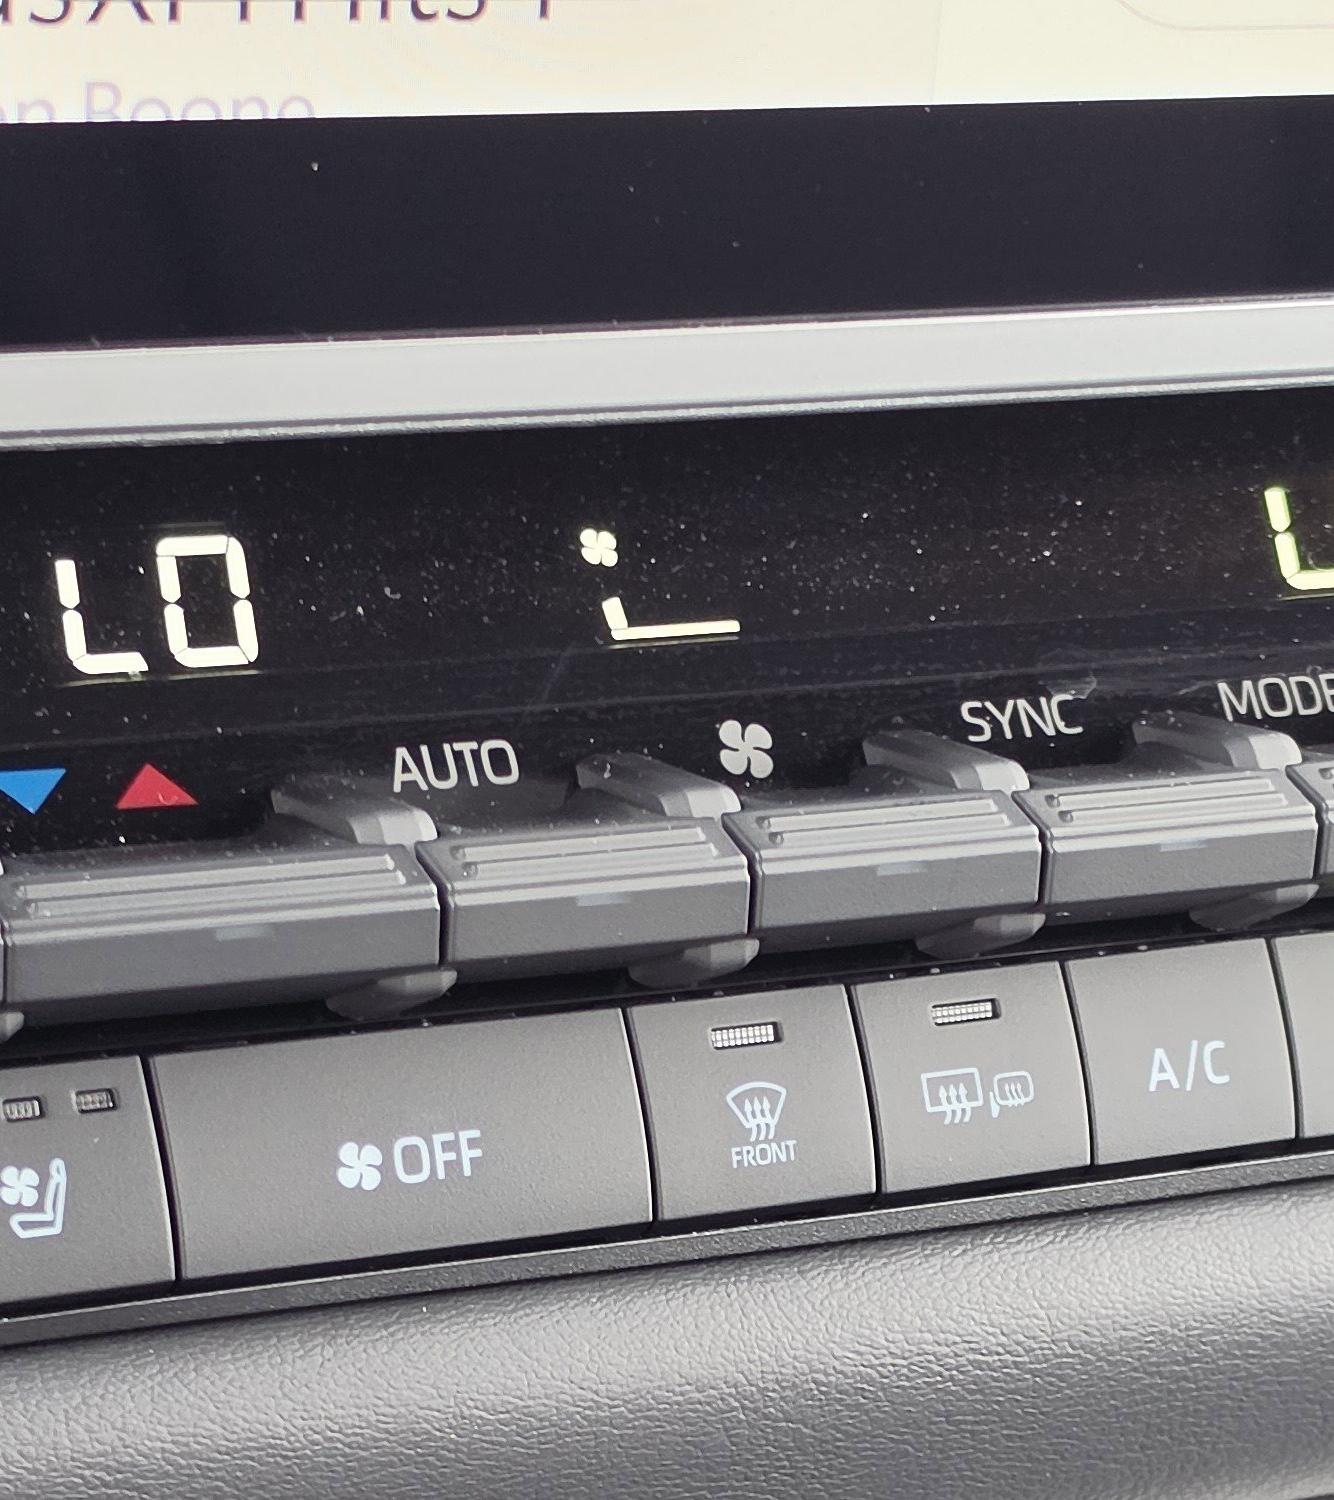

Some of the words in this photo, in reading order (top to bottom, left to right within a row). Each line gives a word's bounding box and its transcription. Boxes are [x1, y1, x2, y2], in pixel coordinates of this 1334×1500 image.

[54, 534, 259, 674] LO
[960, 693, 1084, 742] SYNC
[392, 739, 520, 793] AUTO
[1148, 1039, 1230, 1092] A/C
[393, 1130, 483, 1184] OFF
[730, 1139, 798, 1169] FRONT
